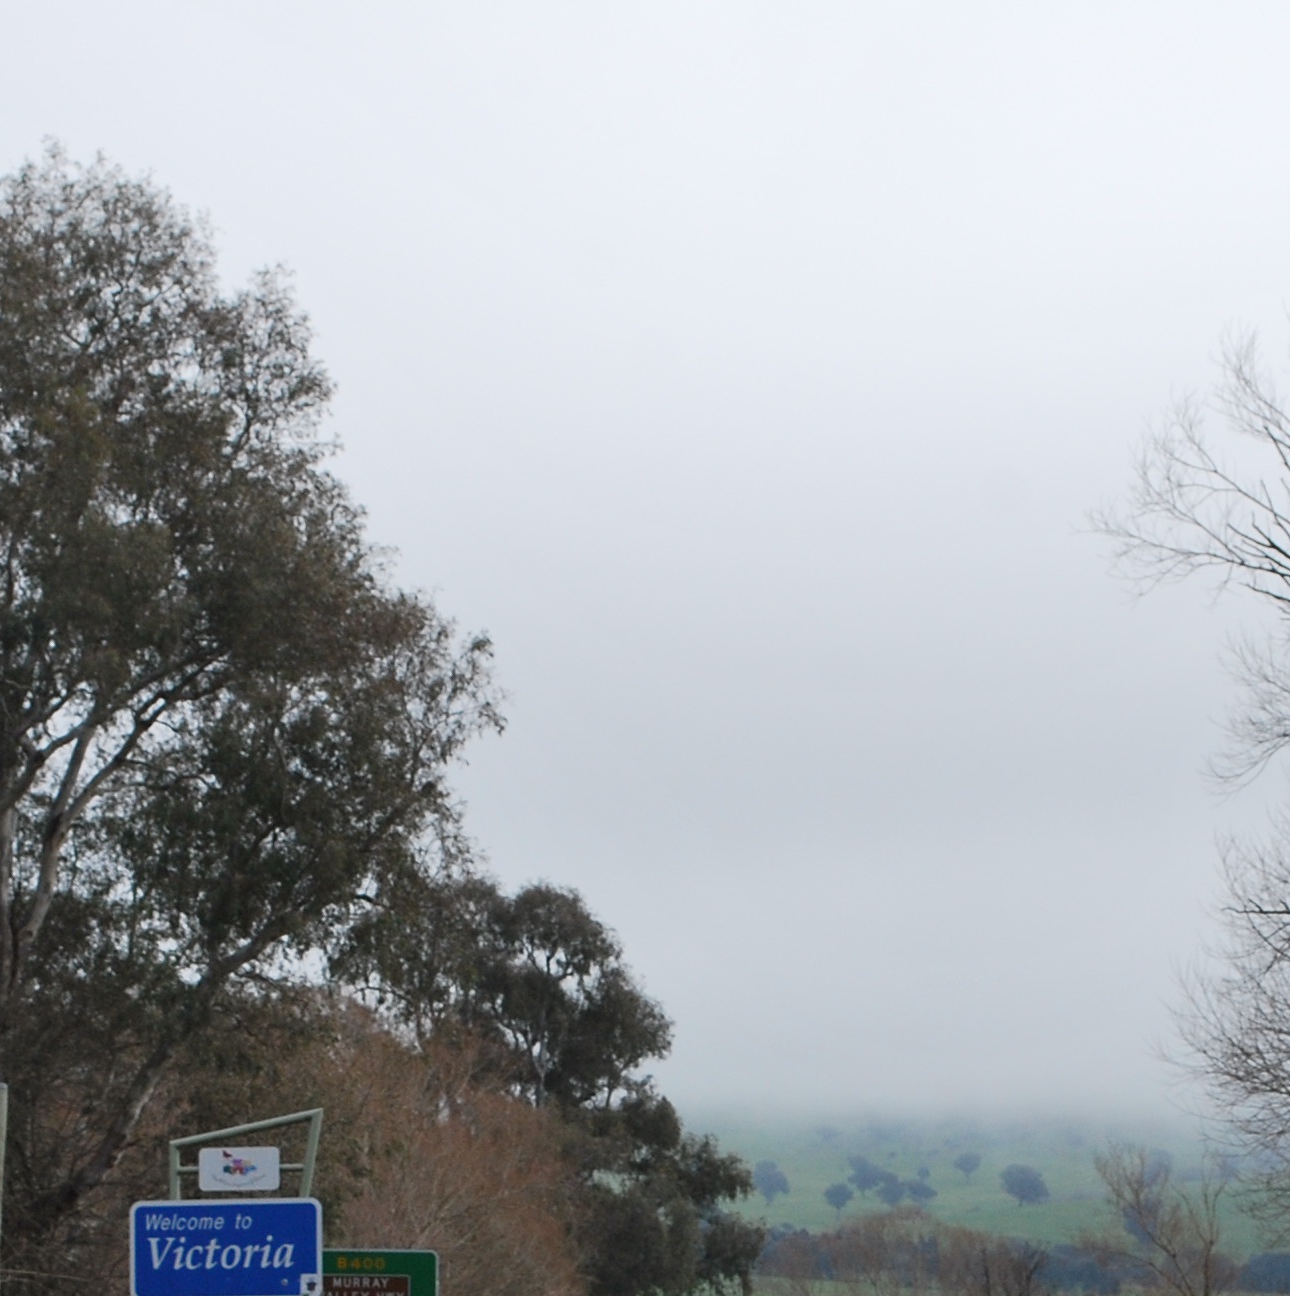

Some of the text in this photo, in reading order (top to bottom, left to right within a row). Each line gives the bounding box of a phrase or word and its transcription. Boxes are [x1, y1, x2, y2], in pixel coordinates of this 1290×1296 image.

[146, 1213, 252, 1230] Welcome to
[147, 1235, 294, 1270] Victoria
[337, 1257, 385, 1269] B400
[333, 1277, 389, 1288] MURRAY
